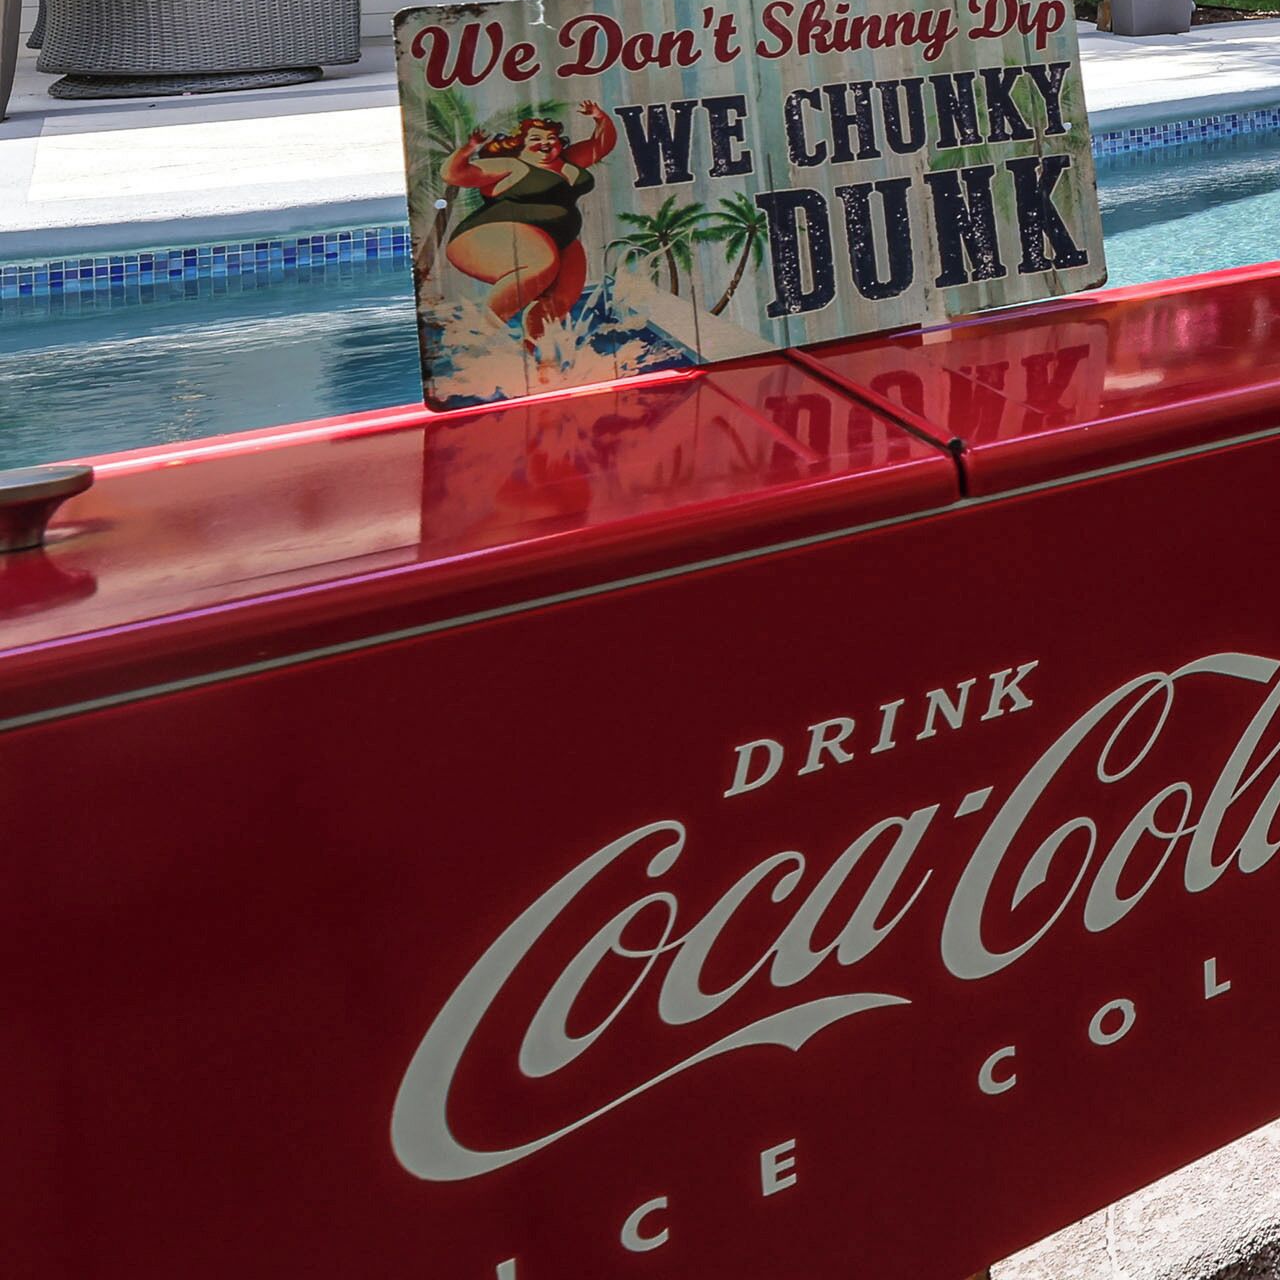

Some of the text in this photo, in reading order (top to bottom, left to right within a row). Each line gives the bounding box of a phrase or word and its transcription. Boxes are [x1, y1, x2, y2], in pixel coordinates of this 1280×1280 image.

[411, 21, 541, 89] We
[555, 5, 741, 78] Don't
[615, 61, 1071, 189] WE CHUNKY
[755, 154, 1089, 319] DUNK
[723, 659, 1040, 799] DRINK
